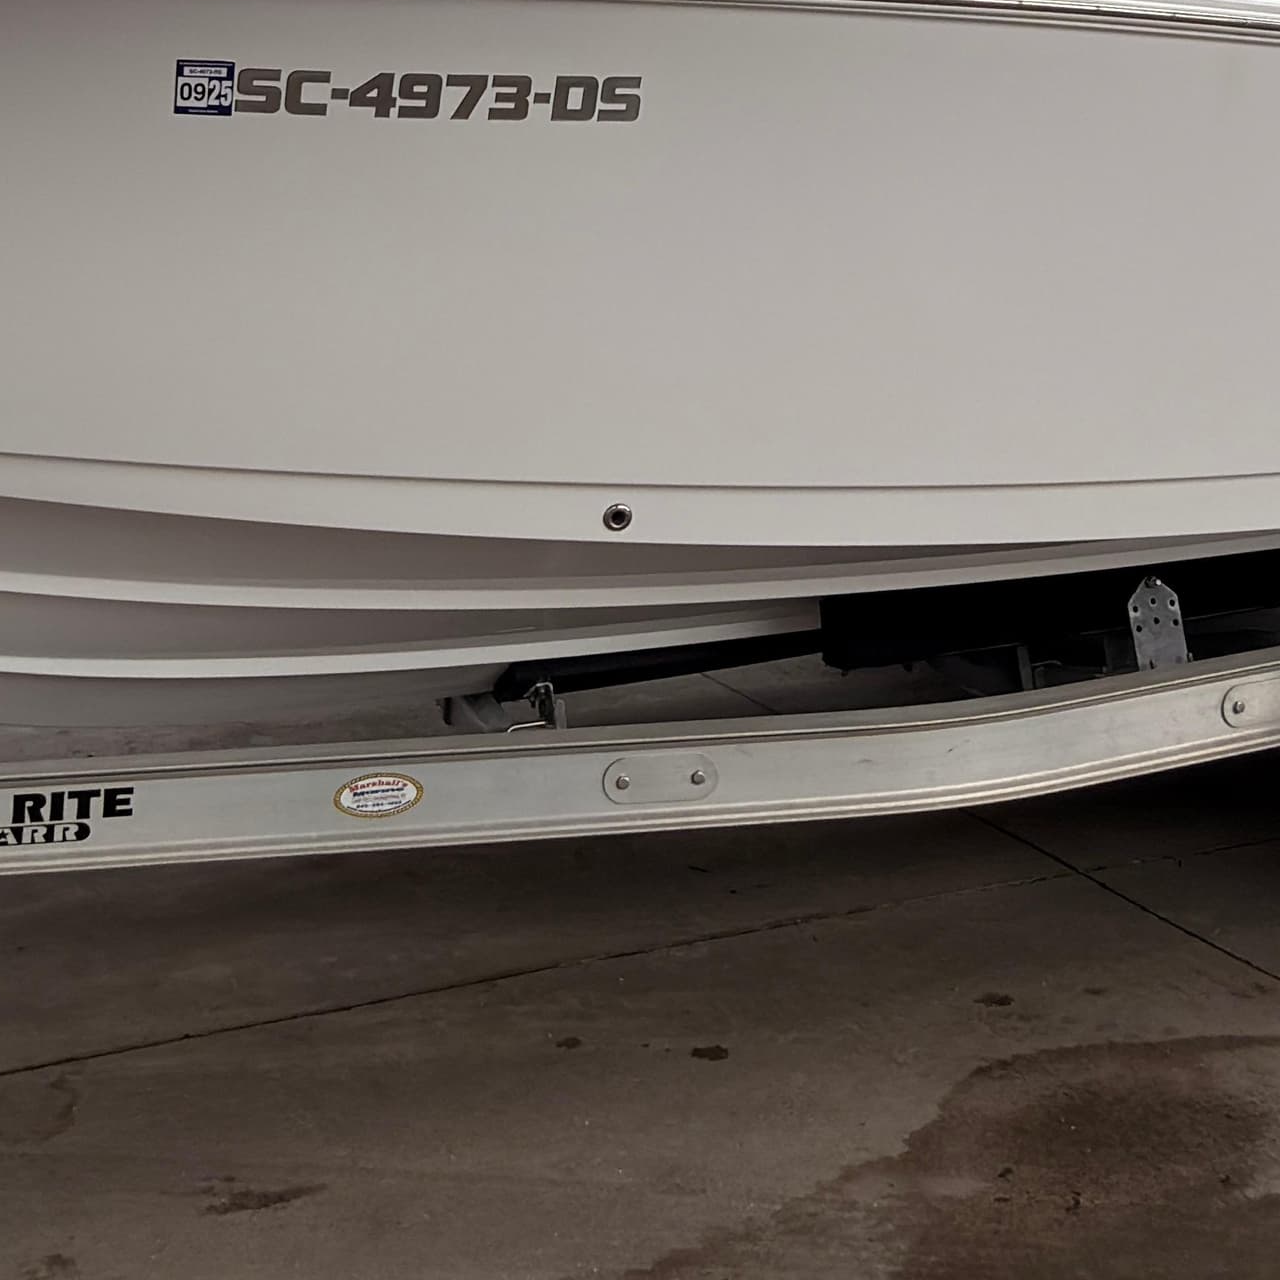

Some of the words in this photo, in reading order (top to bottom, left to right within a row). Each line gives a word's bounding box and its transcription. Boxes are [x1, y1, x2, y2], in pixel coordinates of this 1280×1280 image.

[180, 82, 206, 101] 09
[208, 79, 233, 107] 25
[234, 67, 643, 122] SC-4973-DS
[11, 786, 135, 825] RITE
